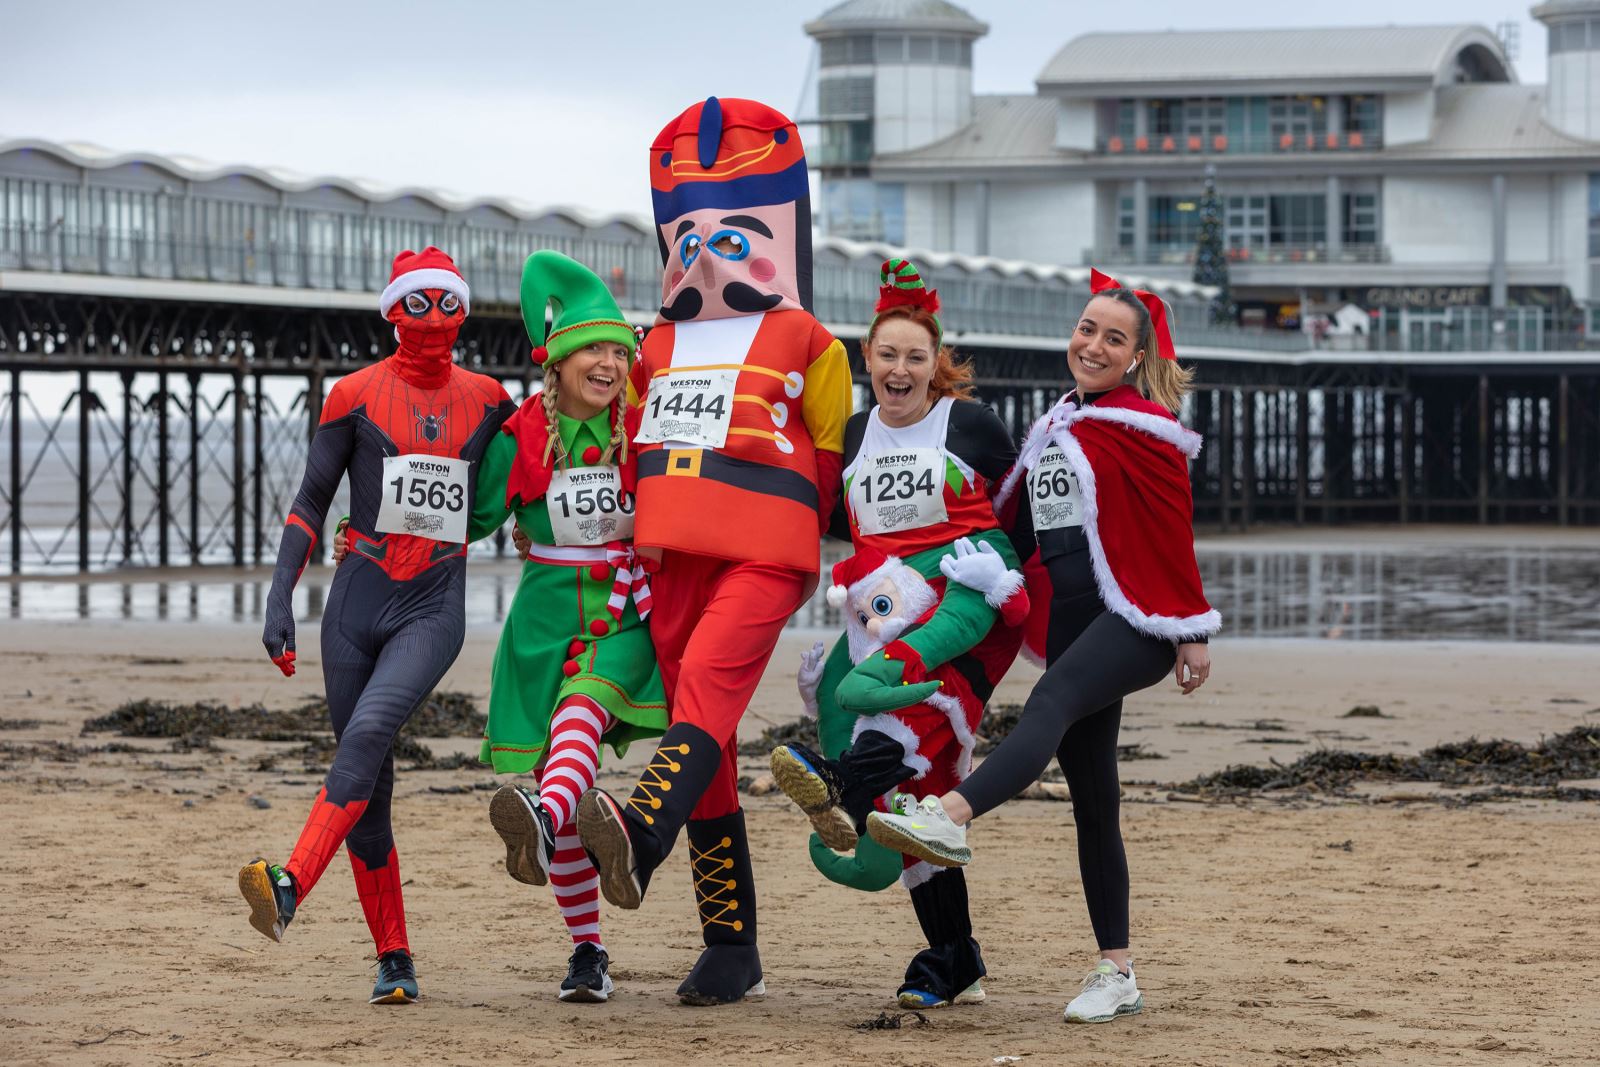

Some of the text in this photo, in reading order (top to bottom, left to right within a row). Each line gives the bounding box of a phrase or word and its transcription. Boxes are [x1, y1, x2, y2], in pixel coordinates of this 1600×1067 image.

[1366, 287, 1432, 306] GRAND
[670, 379, 711, 387] WESTON
[650, 392, 726, 420] 1444
[876, 454, 917, 465] WESTON
[1040, 453, 1068, 464] WESTO
[409, 461, 450, 473] WESTON
[569, 472, 614, 483] WESTON
[860, 468, 935, 504] 1234
[390, 476, 464, 513] 1563
[553, 487, 636, 518] 1560
